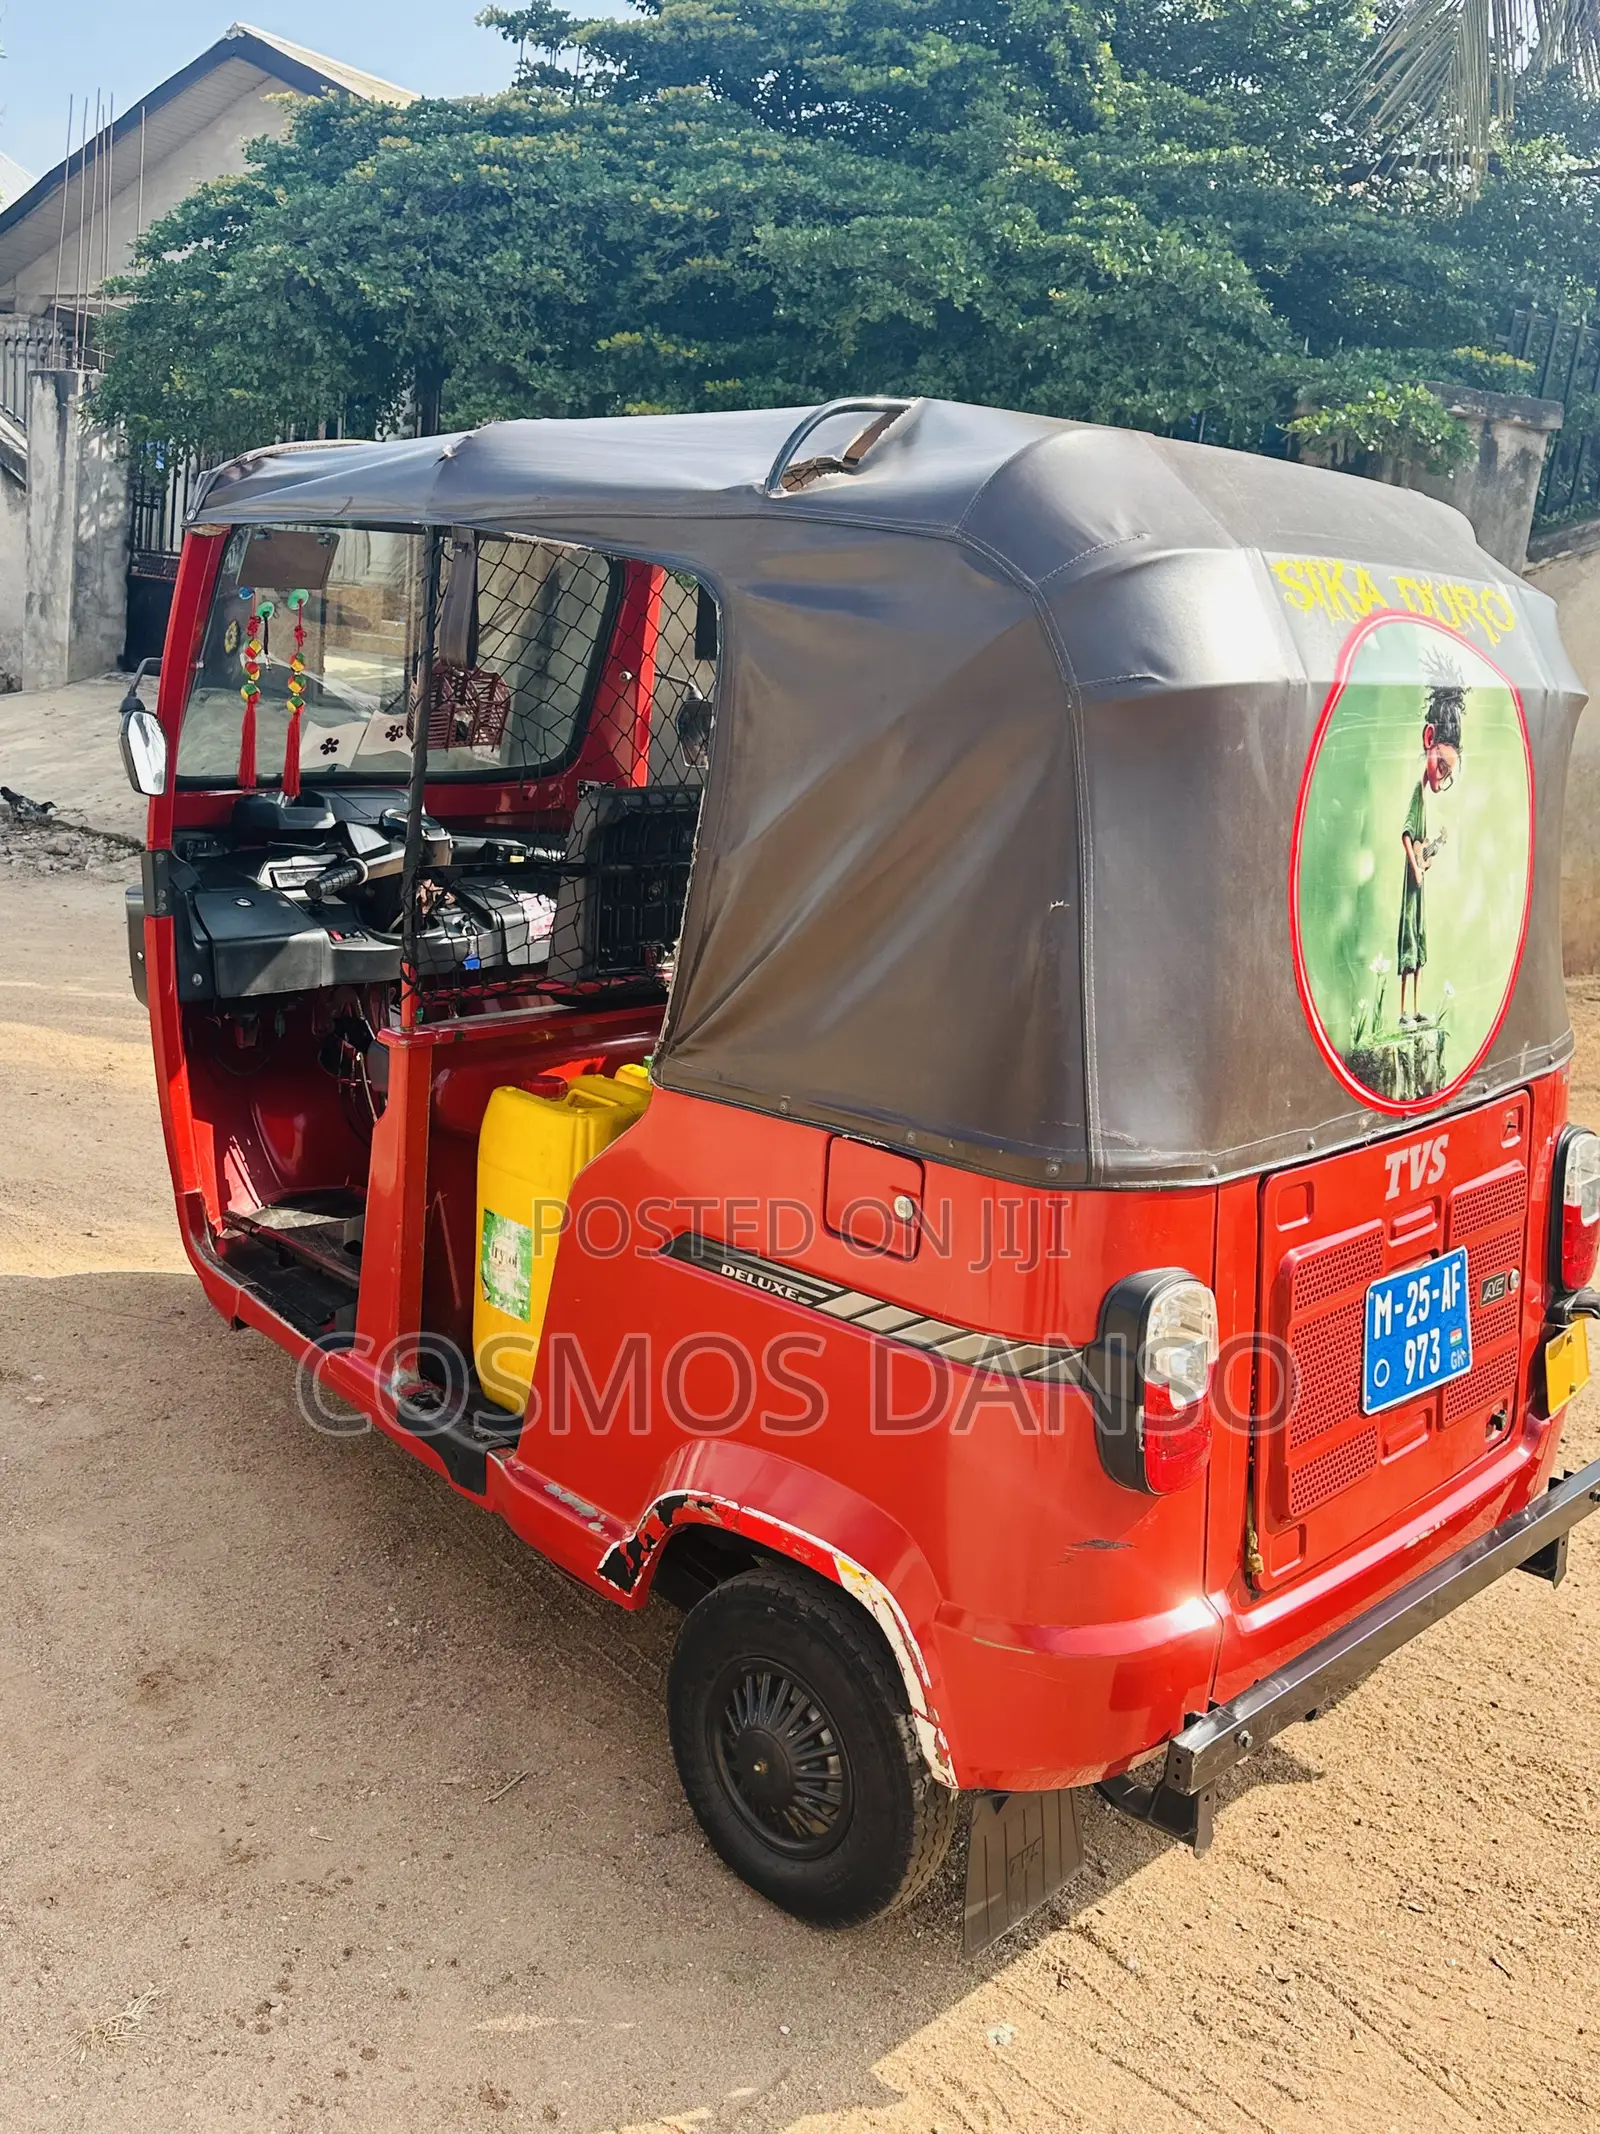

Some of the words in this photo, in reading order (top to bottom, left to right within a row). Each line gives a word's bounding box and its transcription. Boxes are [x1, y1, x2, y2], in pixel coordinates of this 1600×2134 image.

[1270, 557, 1389, 625] SIKA
[1384, 1133, 1450, 1201] TVS
[720, 1263, 800, 1302] DELUXE
[1374, 1261, 1462, 1340] M-25-AF
[1404, 1327, 1440, 1386] 973
